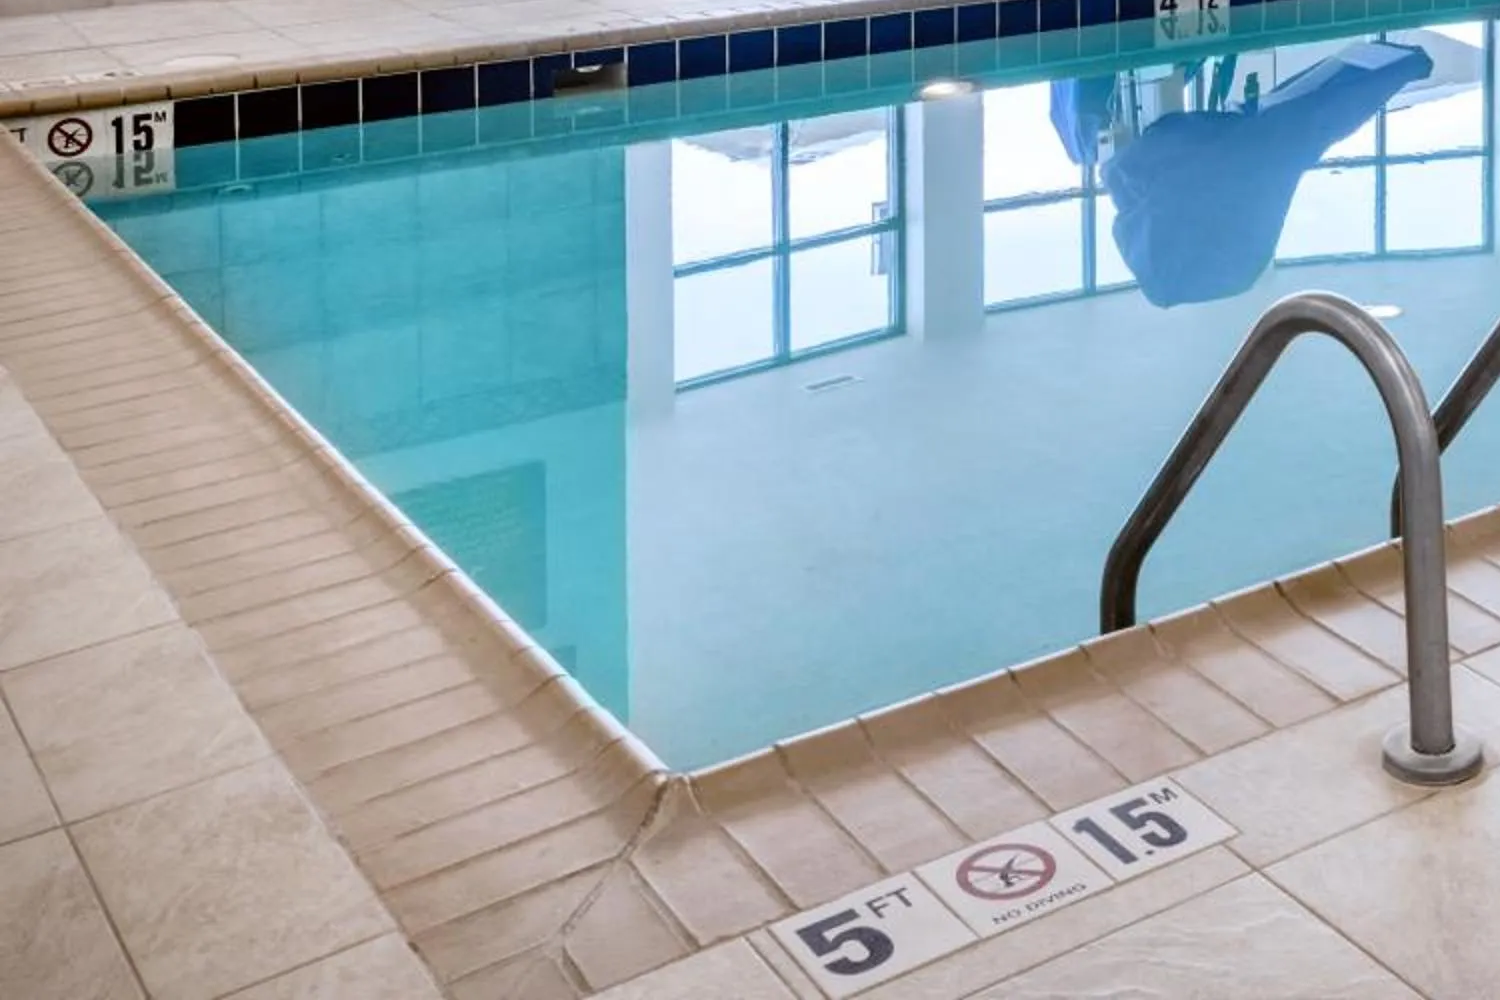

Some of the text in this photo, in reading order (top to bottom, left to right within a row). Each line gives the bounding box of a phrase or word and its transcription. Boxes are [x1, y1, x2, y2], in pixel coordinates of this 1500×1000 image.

[1072, 799, 1188, 866] 1.5
[794, 886, 914, 976] 5 FT
[992, 882, 1087, 925] NO DIVING
